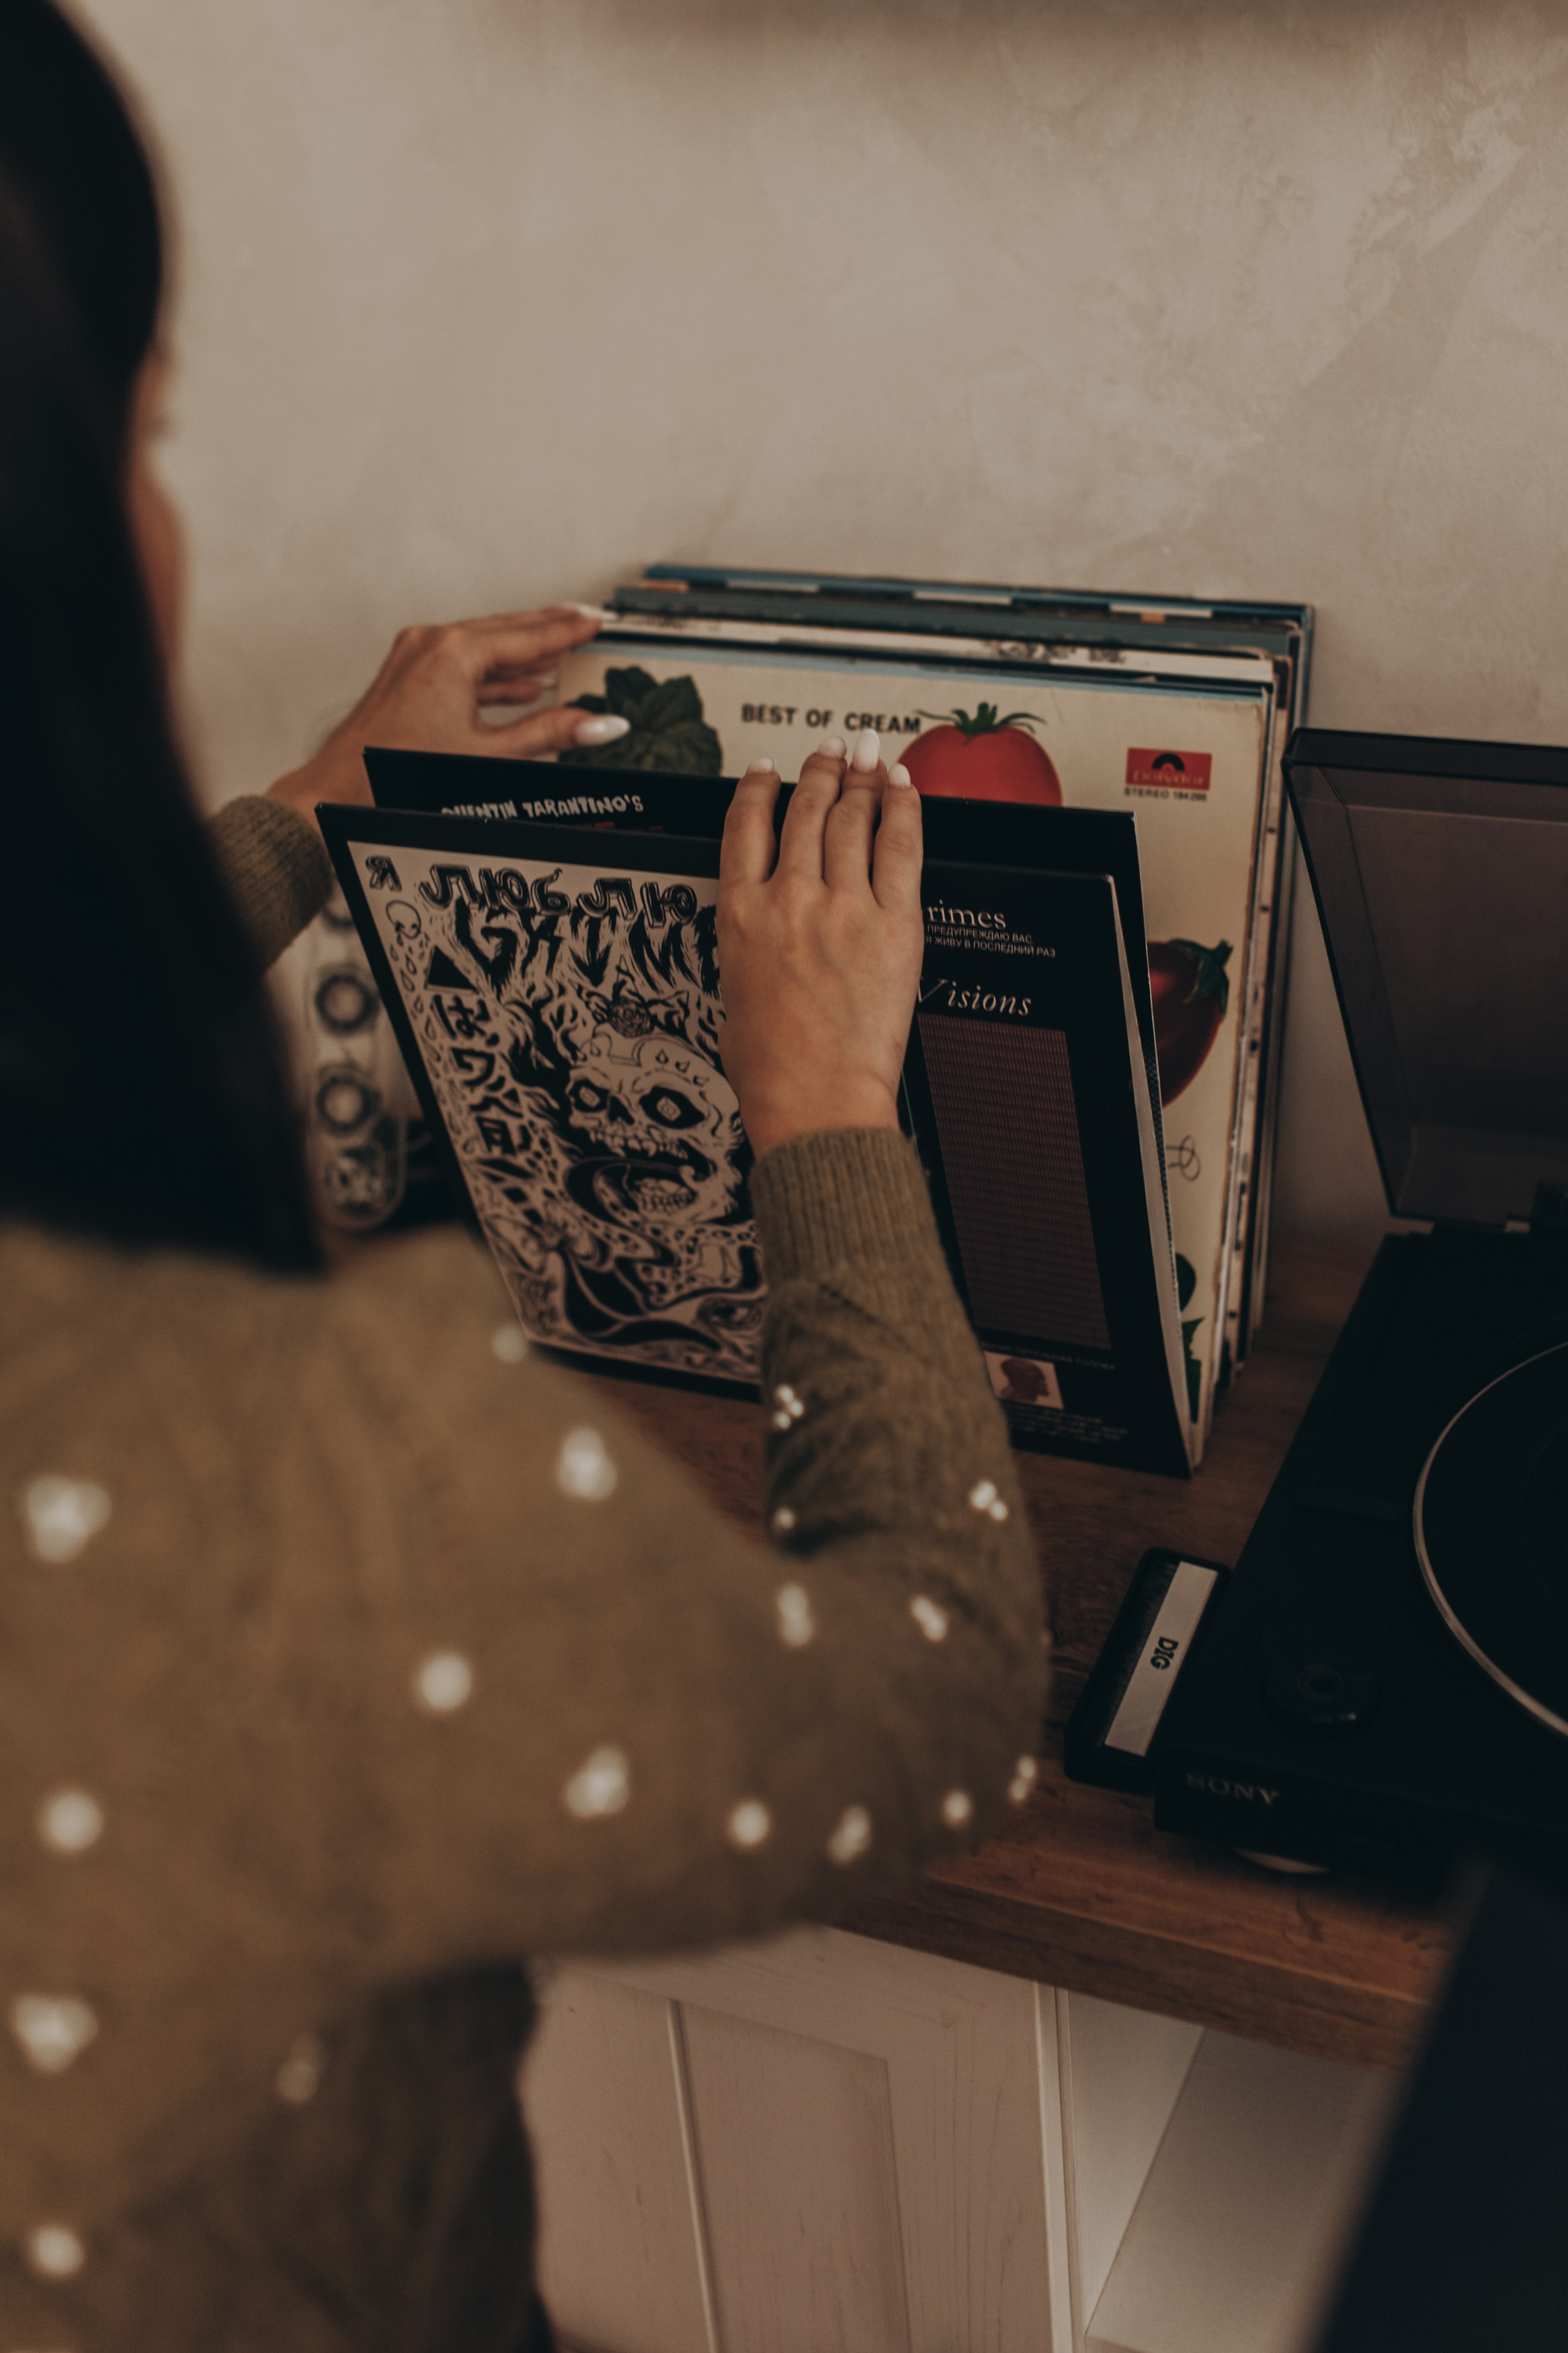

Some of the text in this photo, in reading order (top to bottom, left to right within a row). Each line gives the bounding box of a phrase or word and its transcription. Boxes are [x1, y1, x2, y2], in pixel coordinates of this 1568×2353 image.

[742, 704, 921, 733] BEST OF CREAM
[522, 794, 644, 818] TARANTINO'S
[1125, 787, 1169, 799] STEREO
[366, 856, 401, 891] Я
[927, 899, 1006, 930] rimes
[925, 935, 1056, 959] Я ЖИВУ В ПОСЛЕДНИЙ РАЗ
[927, 924, 1010, 942] ПРЕДУПРЕЖДАЮ
[1150, 1636, 1179, 1670] DIG
[1186, 1770, 1281, 1807] SONY
